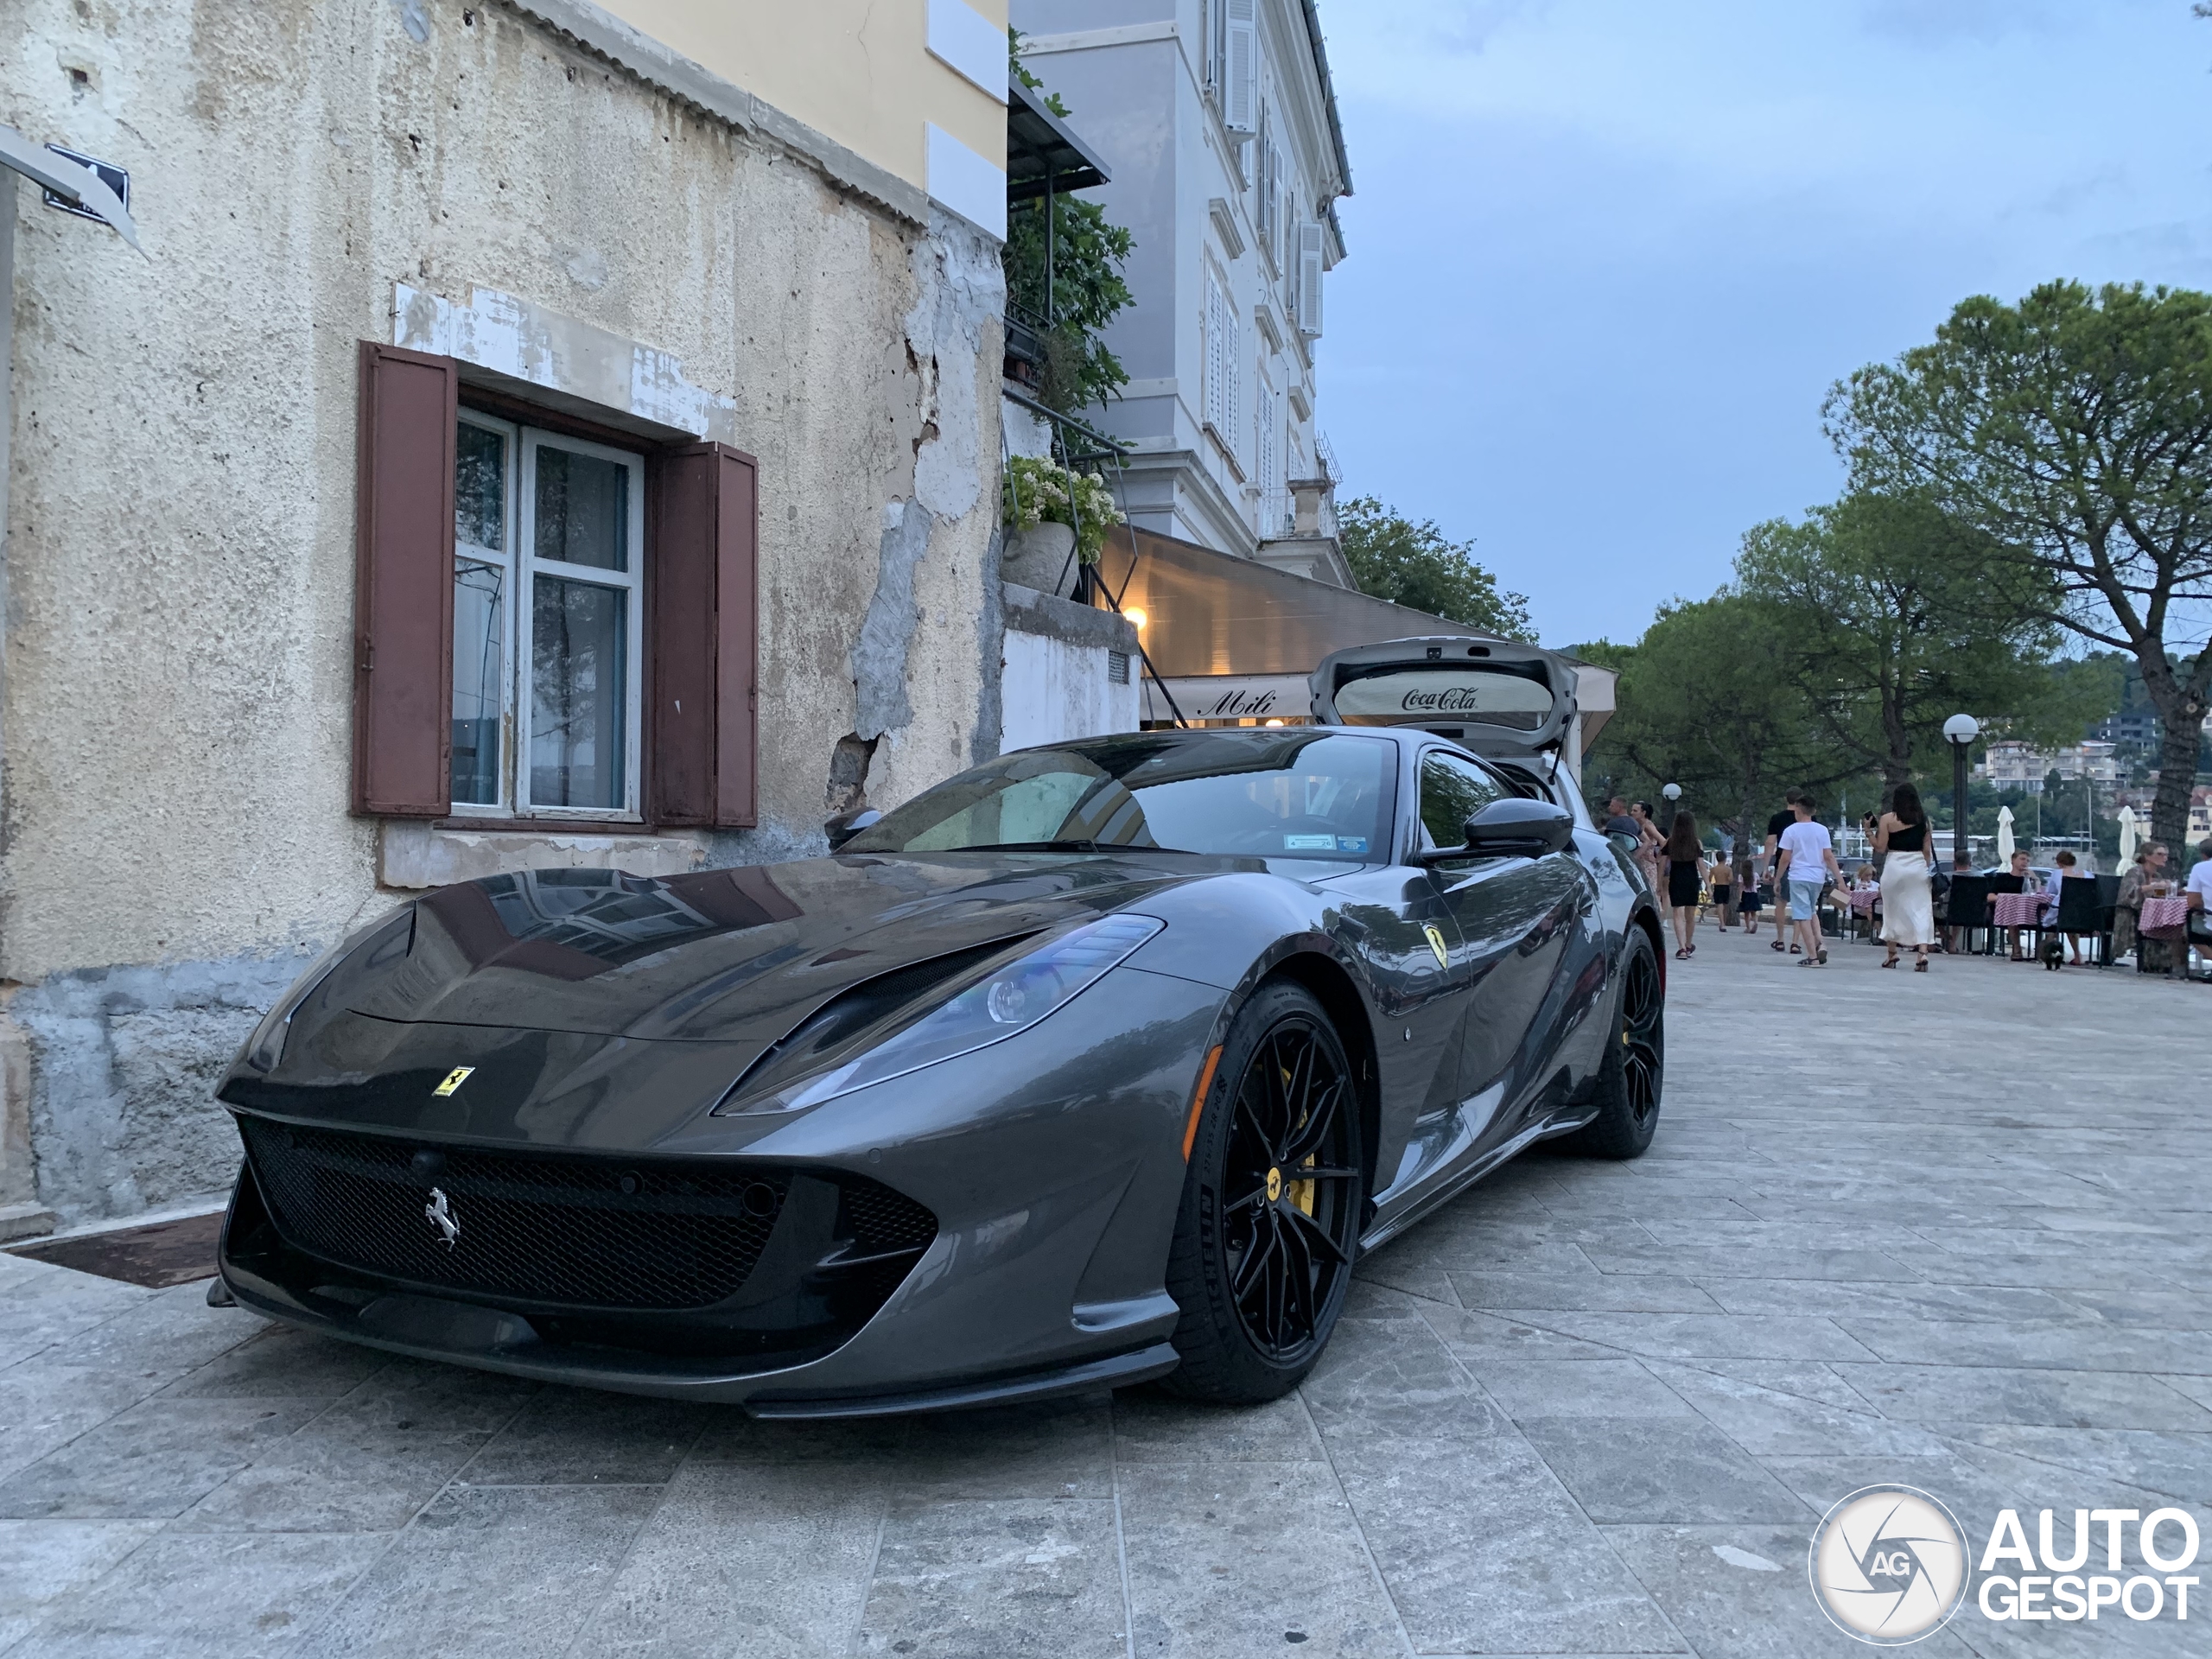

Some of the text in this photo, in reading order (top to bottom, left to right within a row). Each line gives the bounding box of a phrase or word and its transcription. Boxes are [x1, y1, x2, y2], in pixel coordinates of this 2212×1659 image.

[1197, 690, 1276, 716] Mili
[1402, 687, 1479, 711] Coca-Cola
[1201, 1193, 1229, 1329] MICHELIN
